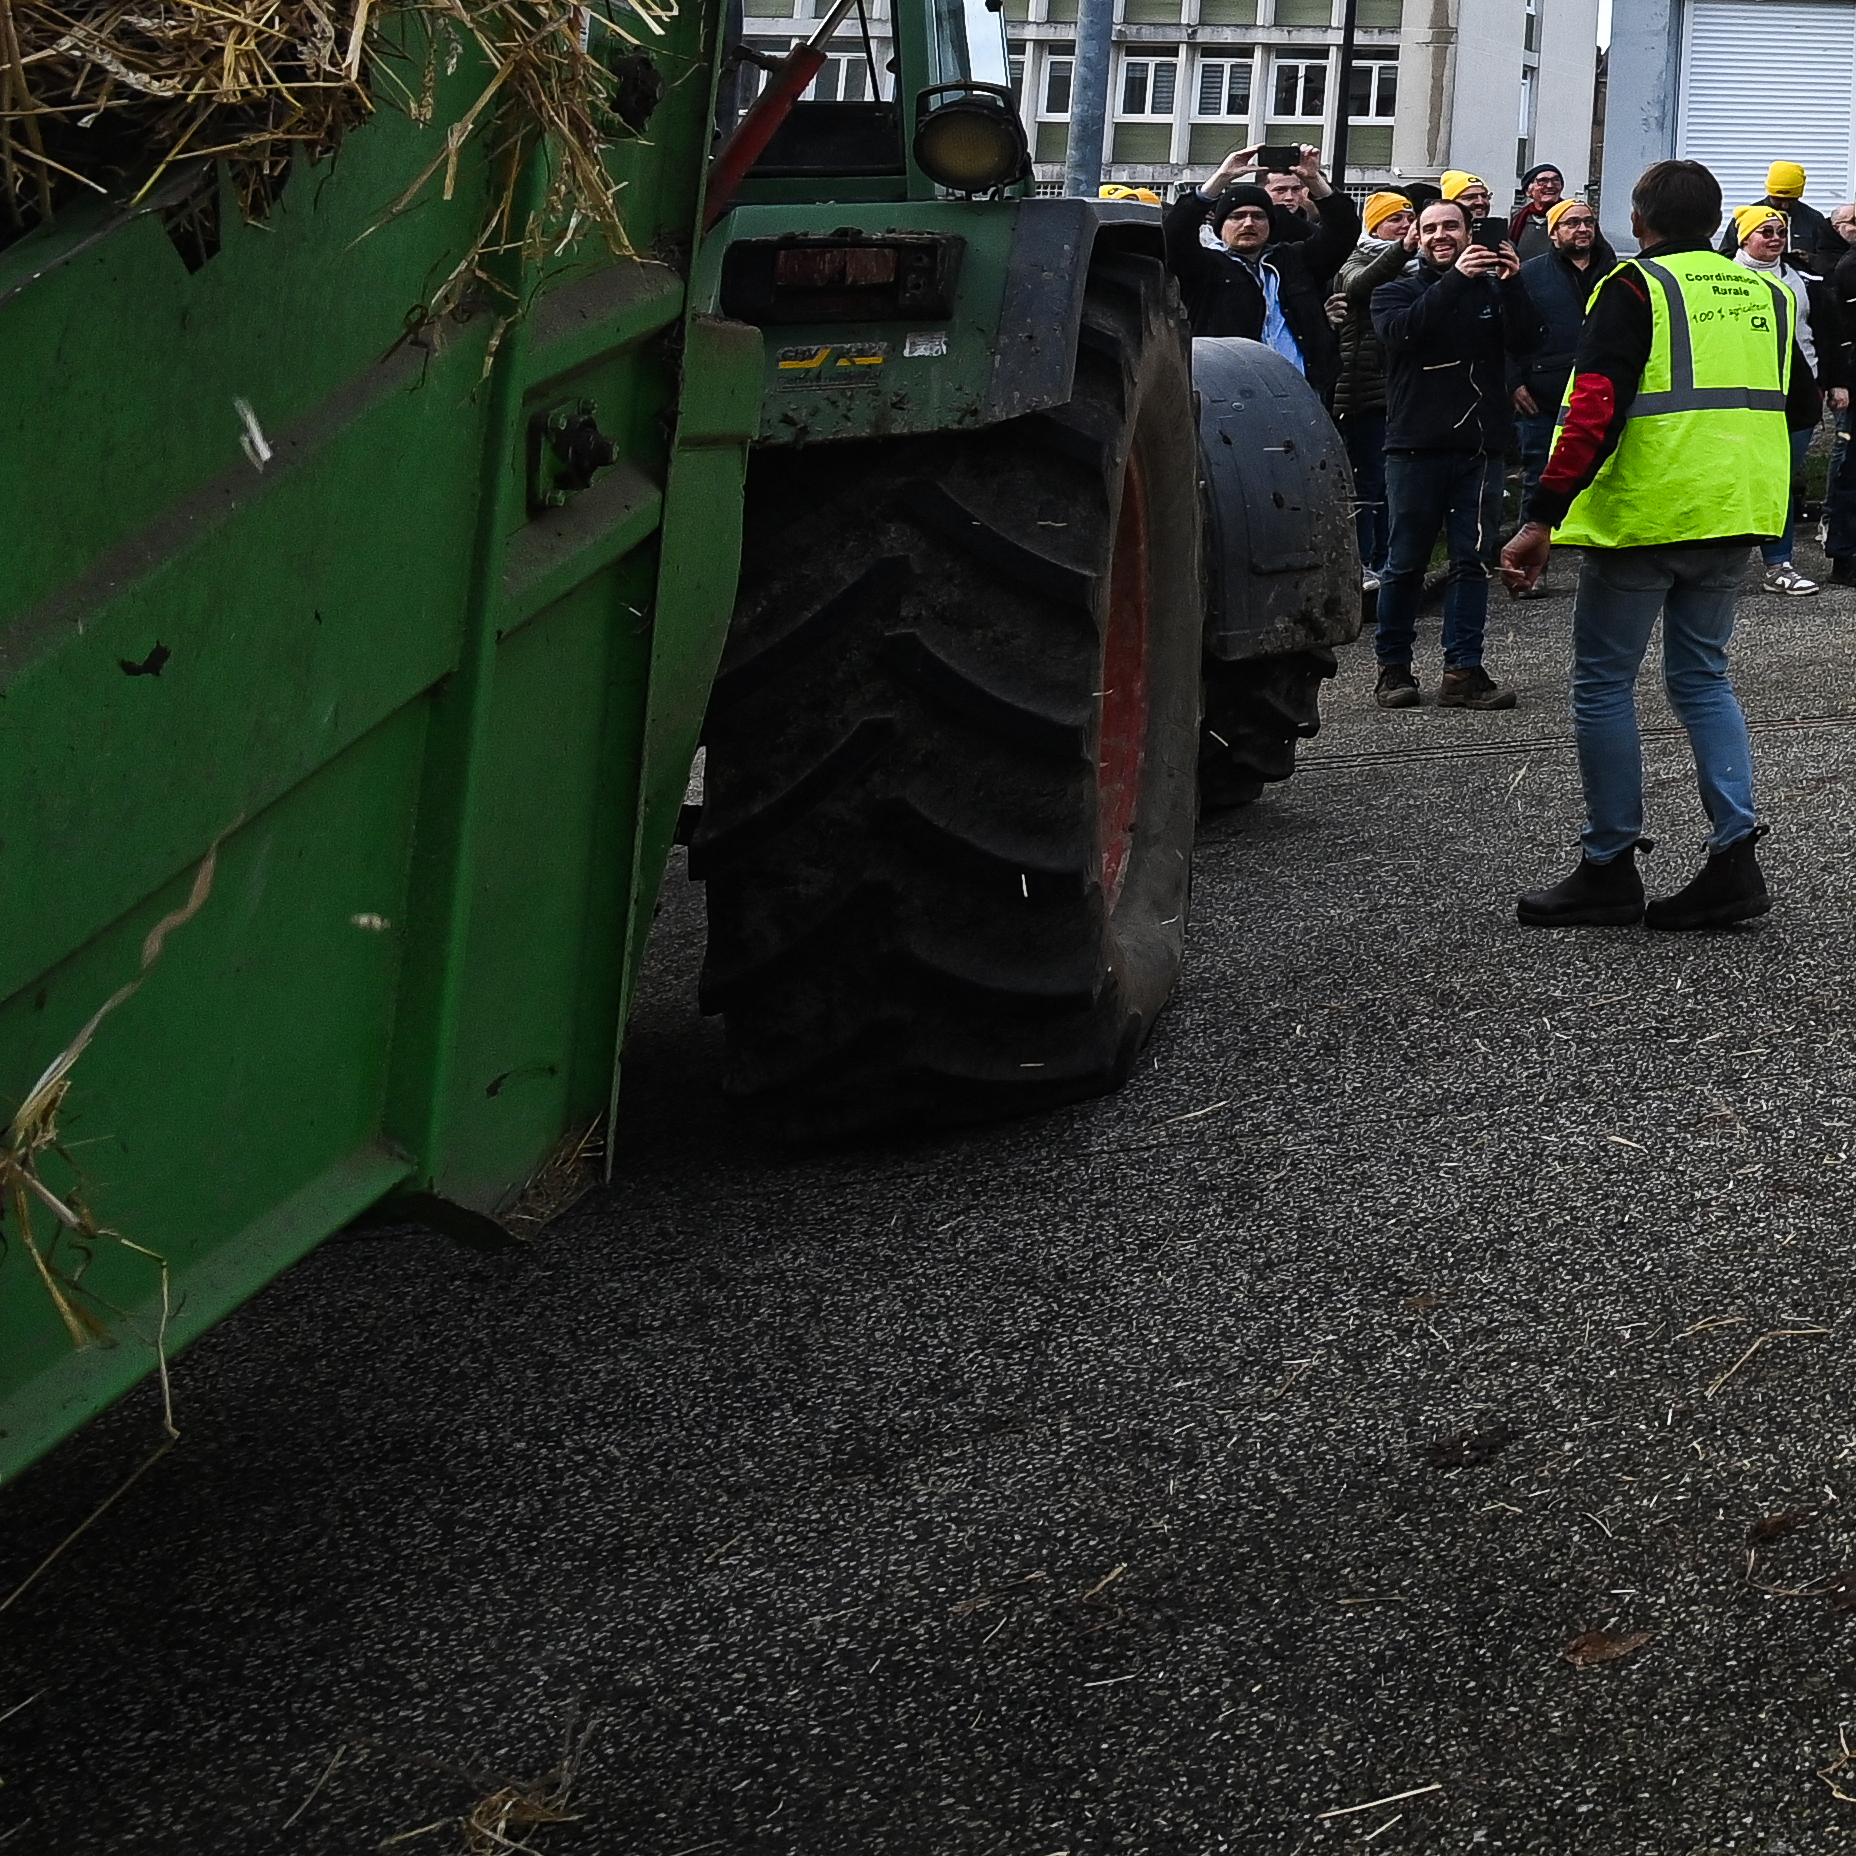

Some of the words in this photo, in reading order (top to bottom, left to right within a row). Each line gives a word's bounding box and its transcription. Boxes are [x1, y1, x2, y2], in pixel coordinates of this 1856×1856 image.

[1685, 272, 1759, 286] Coordination
[1712, 285, 1750, 296] Rurale
[1692, 310, 1714, 324] 100
